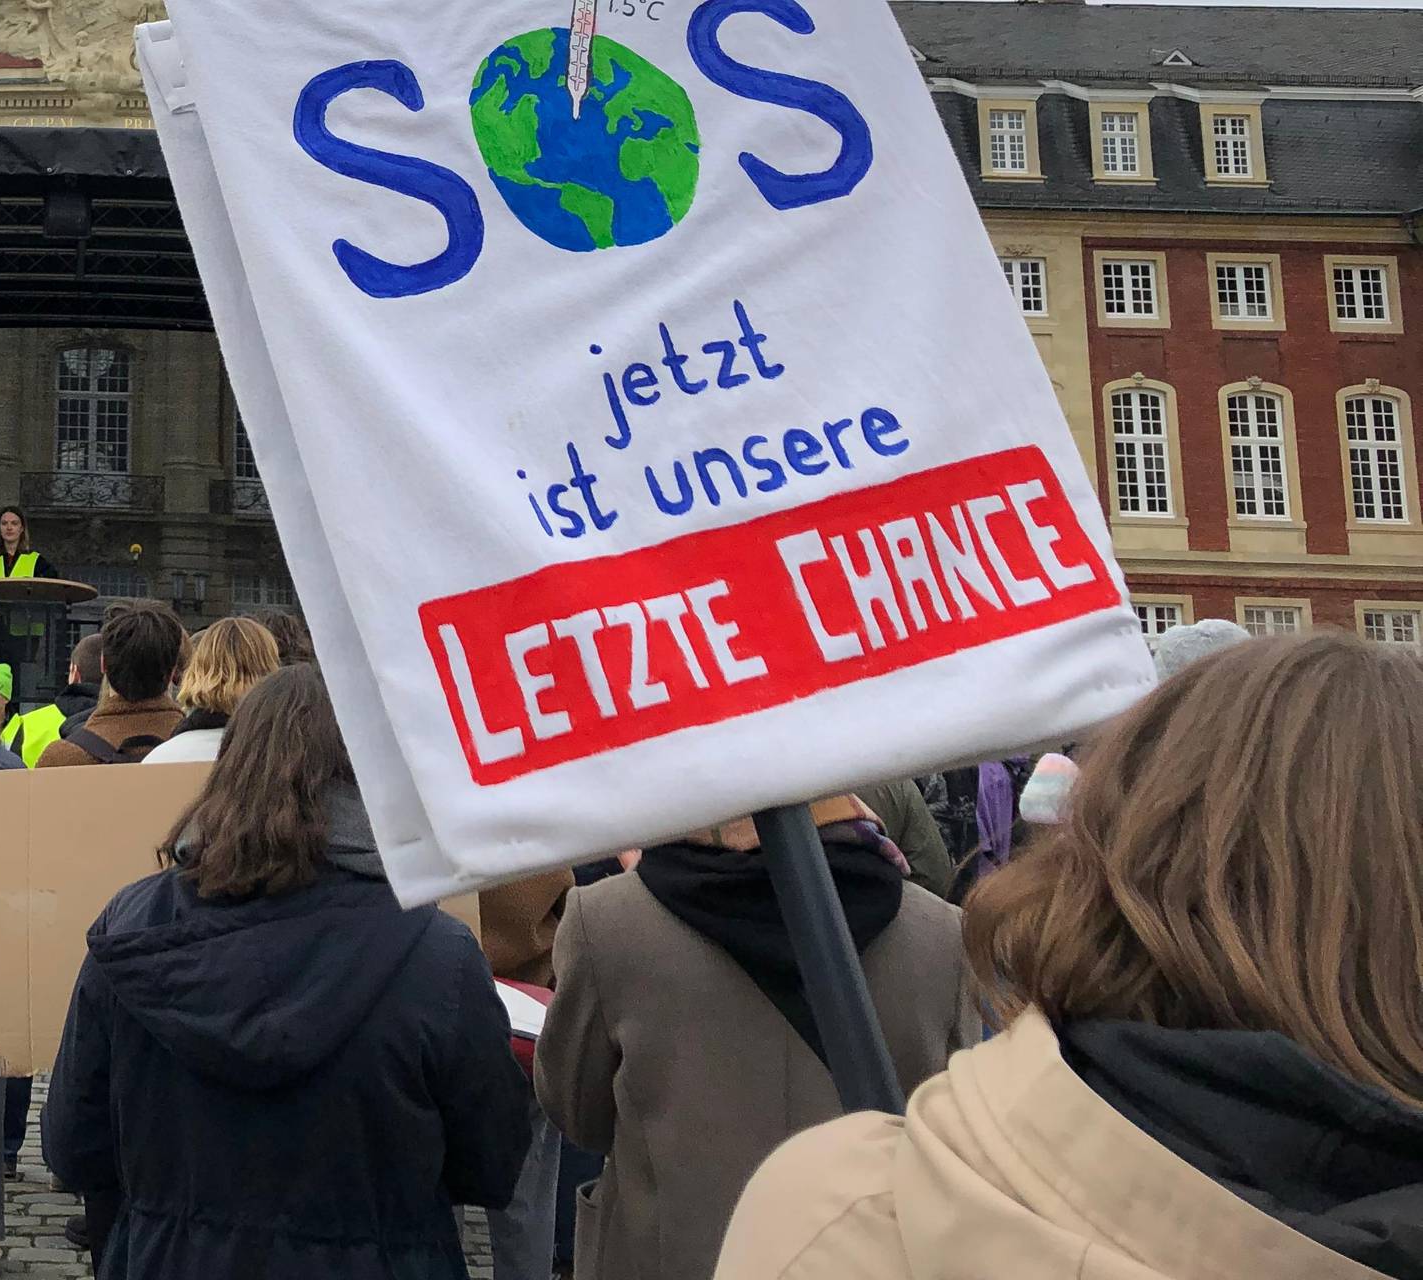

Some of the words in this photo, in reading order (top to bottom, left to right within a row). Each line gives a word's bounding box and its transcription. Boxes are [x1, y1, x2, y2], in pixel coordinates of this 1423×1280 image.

[589, 299, 785, 450] jetzt
[517, 442, 618, 538] ist
[644, 407, 910, 516] unsere
[439, 579, 768, 765] LETZTE
[777, 478, 1097, 663] CHANCE
